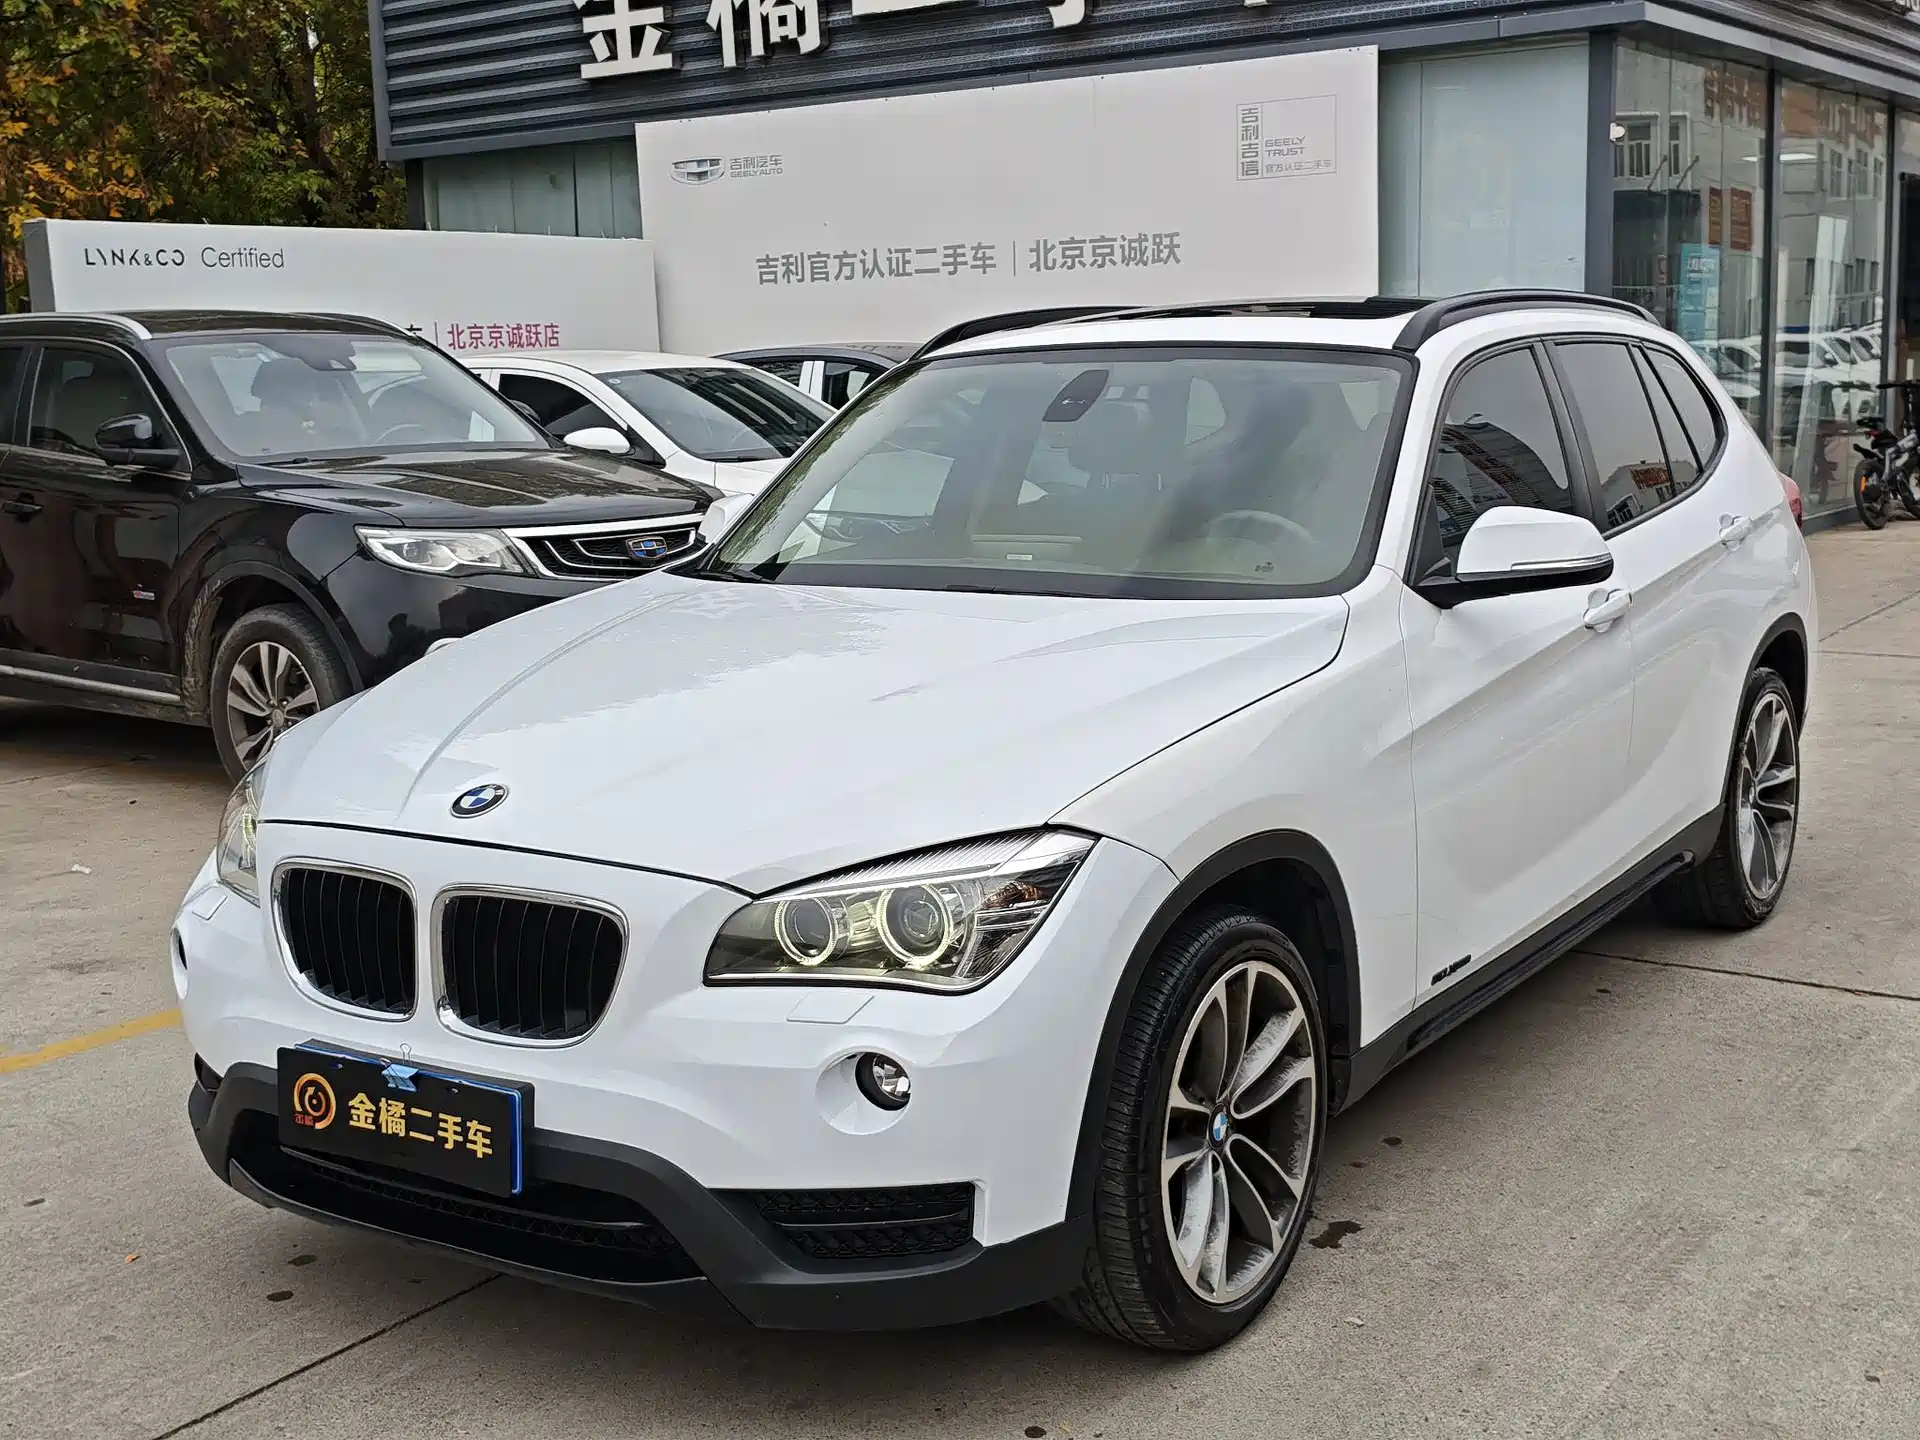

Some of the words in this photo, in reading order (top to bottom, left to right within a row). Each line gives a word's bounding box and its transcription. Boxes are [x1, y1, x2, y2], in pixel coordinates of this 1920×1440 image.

[1265, 136, 1305, 148] GEELY
[1265, 147, 1305, 157] TRUST
[730, 155, 782, 170] 吉利汽车
[201, 246, 285, 268] Certified
[756, 241, 998, 286] 吉利官方认证二手车
[1028, 231, 1182, 273] 北京京诚跃
[447, 322, 560, 350] 北京京诚跃店
[348, 1092, 493, 1159] 金橘二手车
